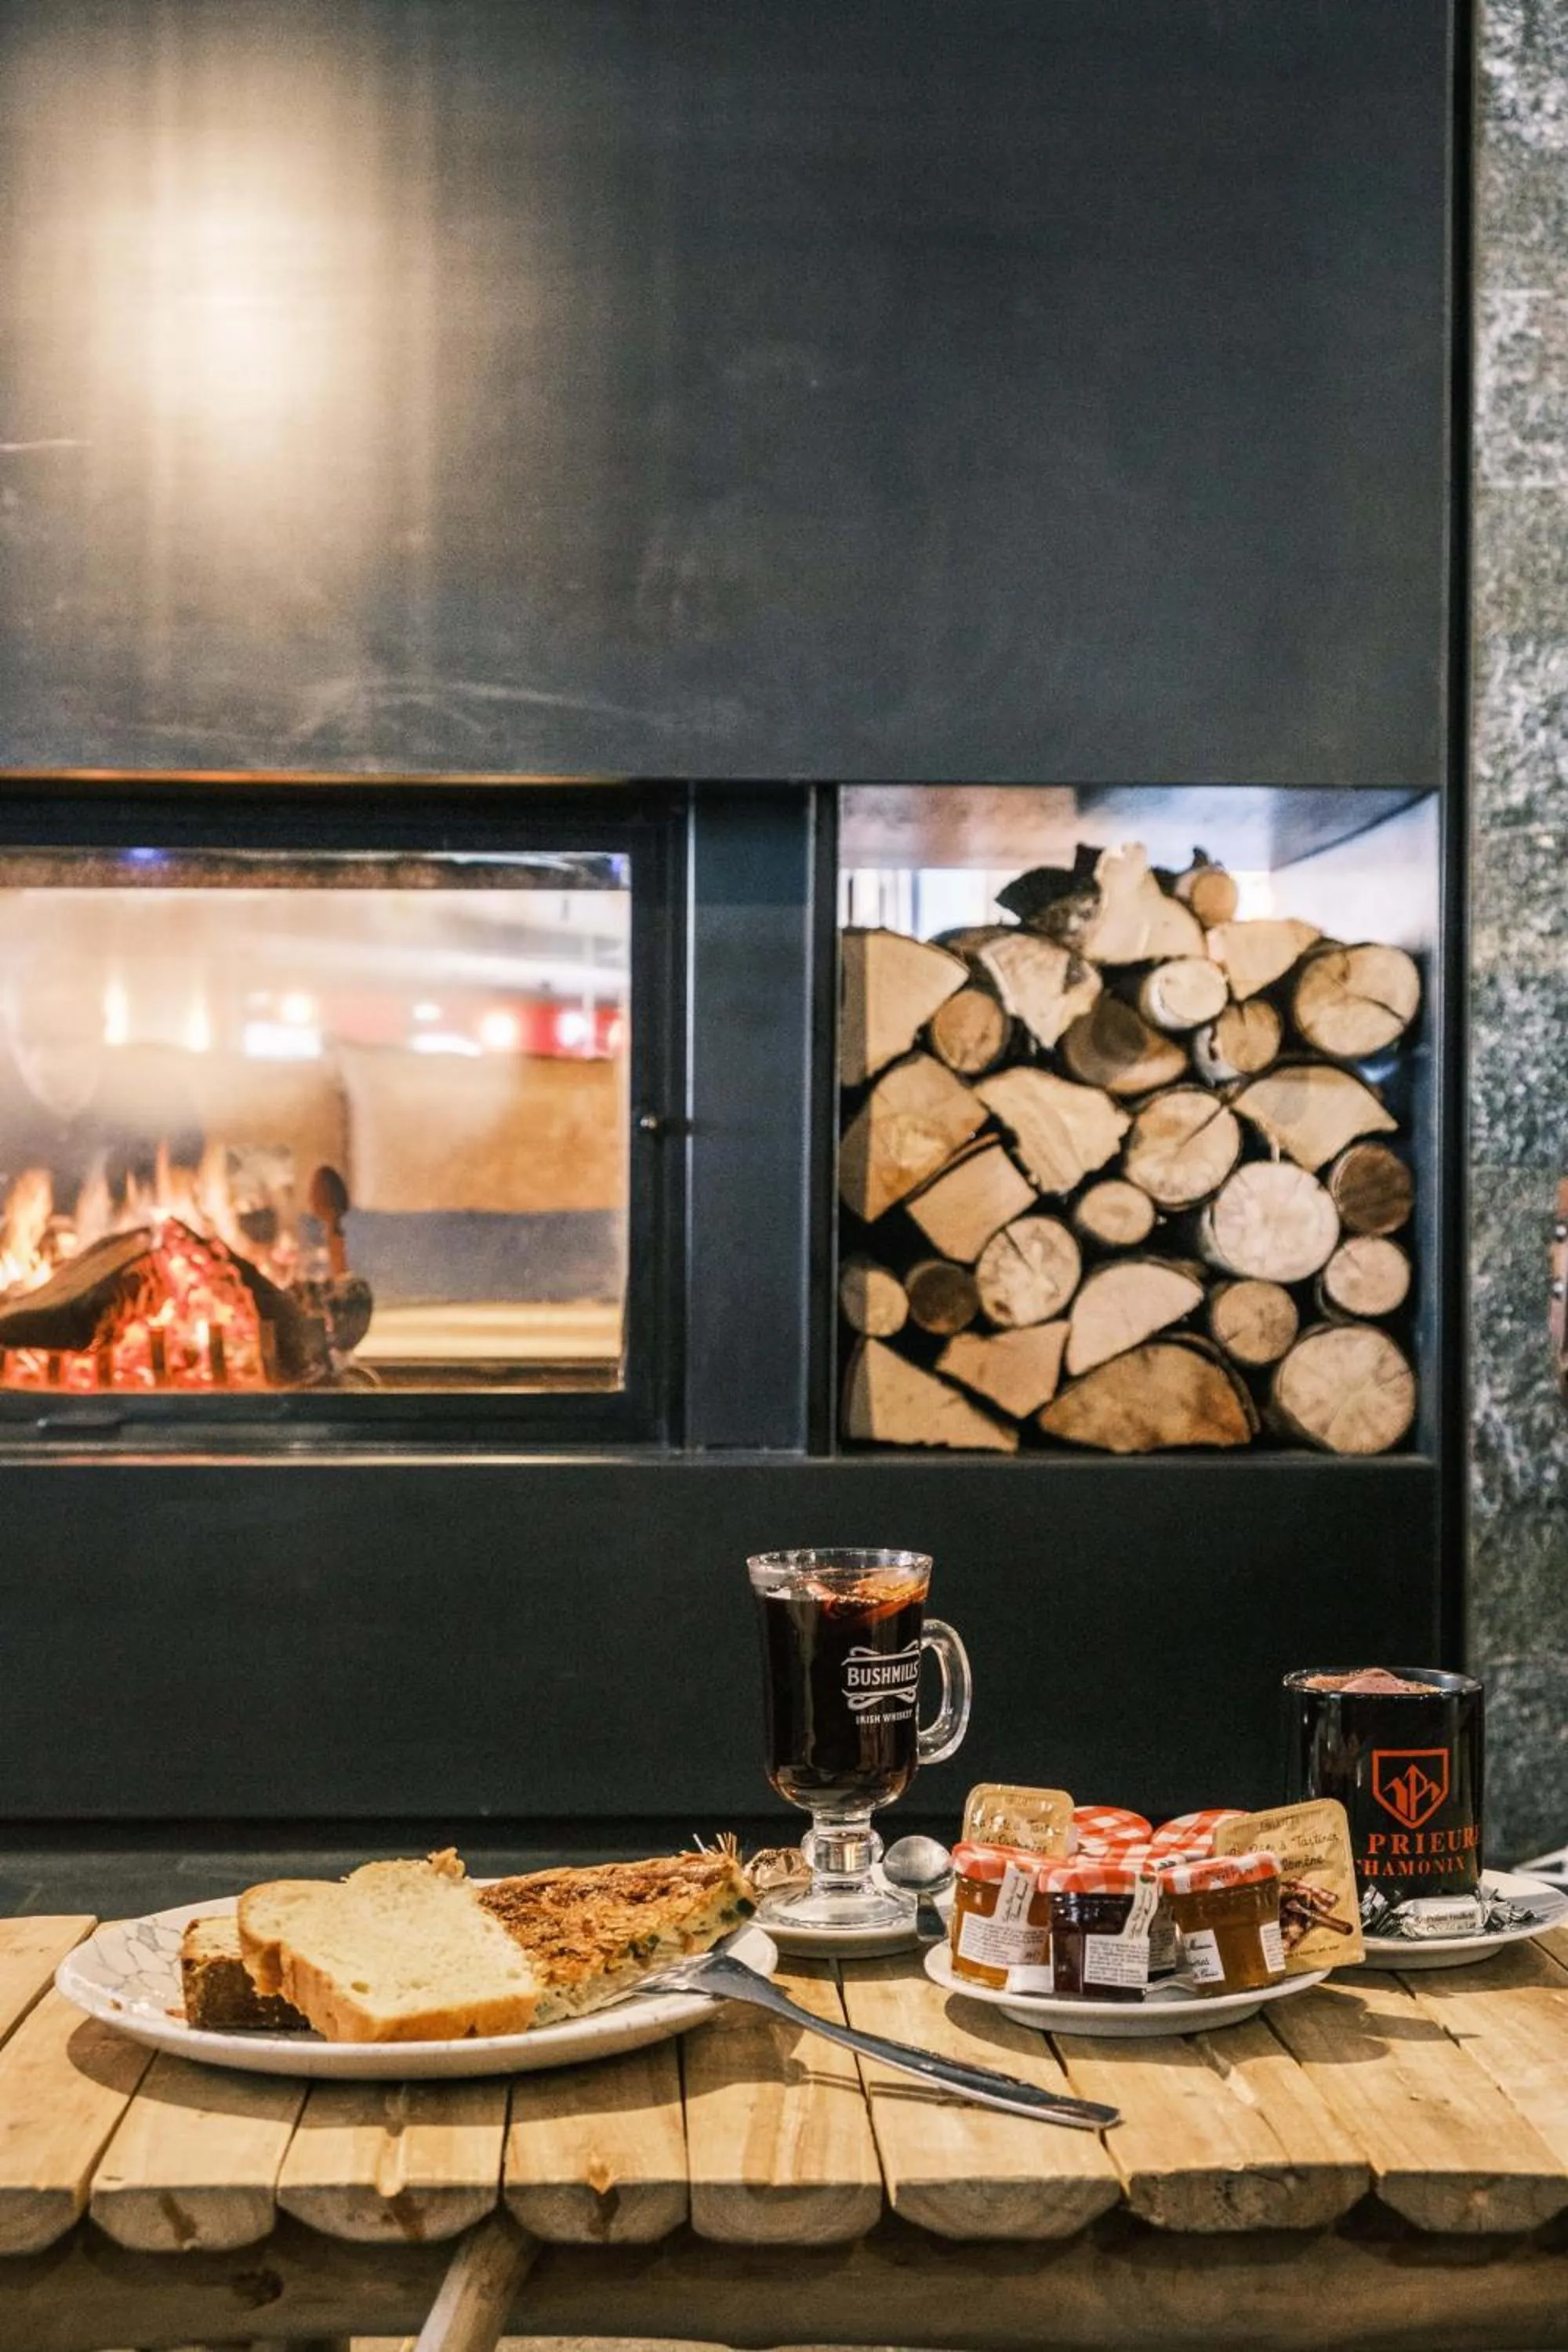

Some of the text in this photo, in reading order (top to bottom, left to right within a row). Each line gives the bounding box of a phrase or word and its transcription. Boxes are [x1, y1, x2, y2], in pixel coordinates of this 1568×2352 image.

[848, 1661, 918, 1686] BUSHMILLS
[855, 1714, 881, 1725] IRISH
[1356, 1855, 1465, 1877] HAMONIX
